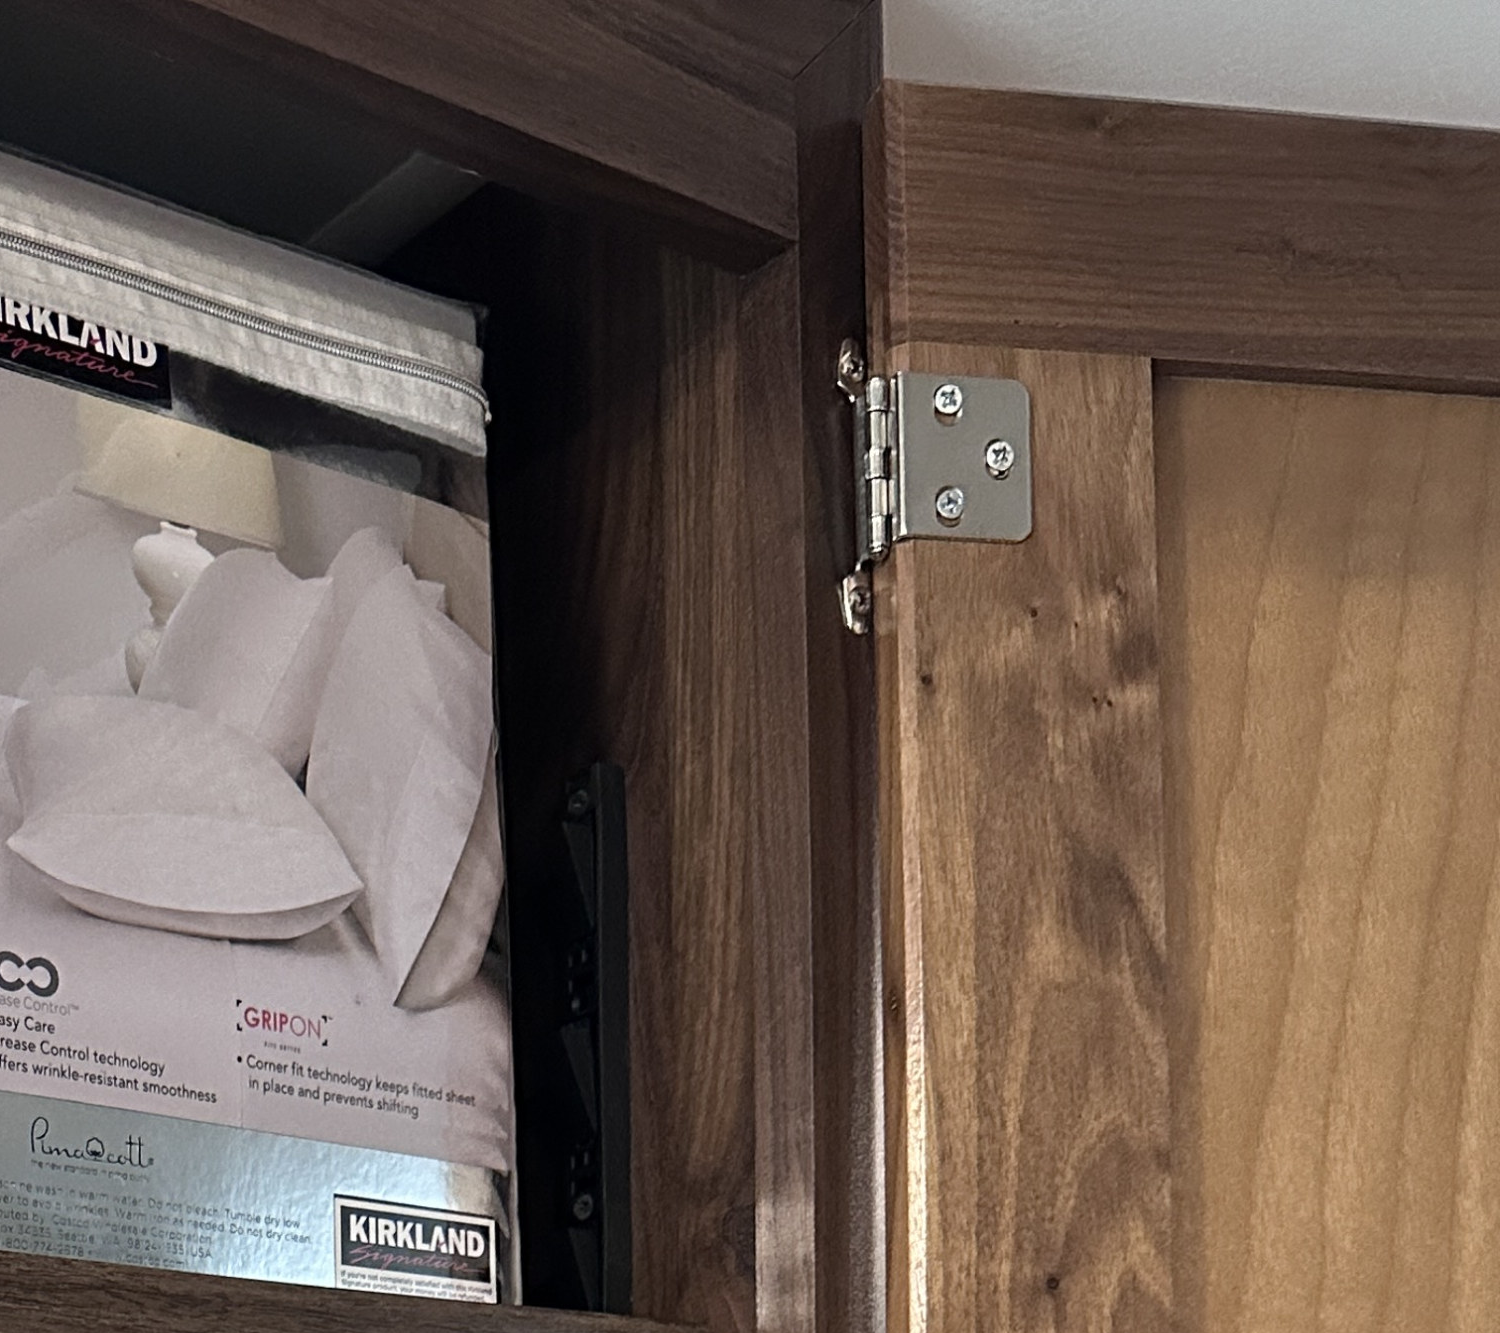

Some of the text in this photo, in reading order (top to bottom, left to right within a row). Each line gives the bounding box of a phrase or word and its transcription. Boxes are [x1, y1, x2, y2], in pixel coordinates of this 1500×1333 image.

[24, 1015, 55, 1035] Care
[39, 1039, 90, 1061] Control
[93, 1050, 165, 1078] technology
[31, 1064, 139, 1091] wrinkle-resistant
[142, 1081, 217, 1104] smoothness
[246, 1053, 476, 1107] Corner fit technology keeps fitted sheet
[248, 1077, 419, 1120] in place and prevents shifting
[350, 1214, 485, 1258] KIRKLAND
[350, 1243, 484, 1273] Signature
